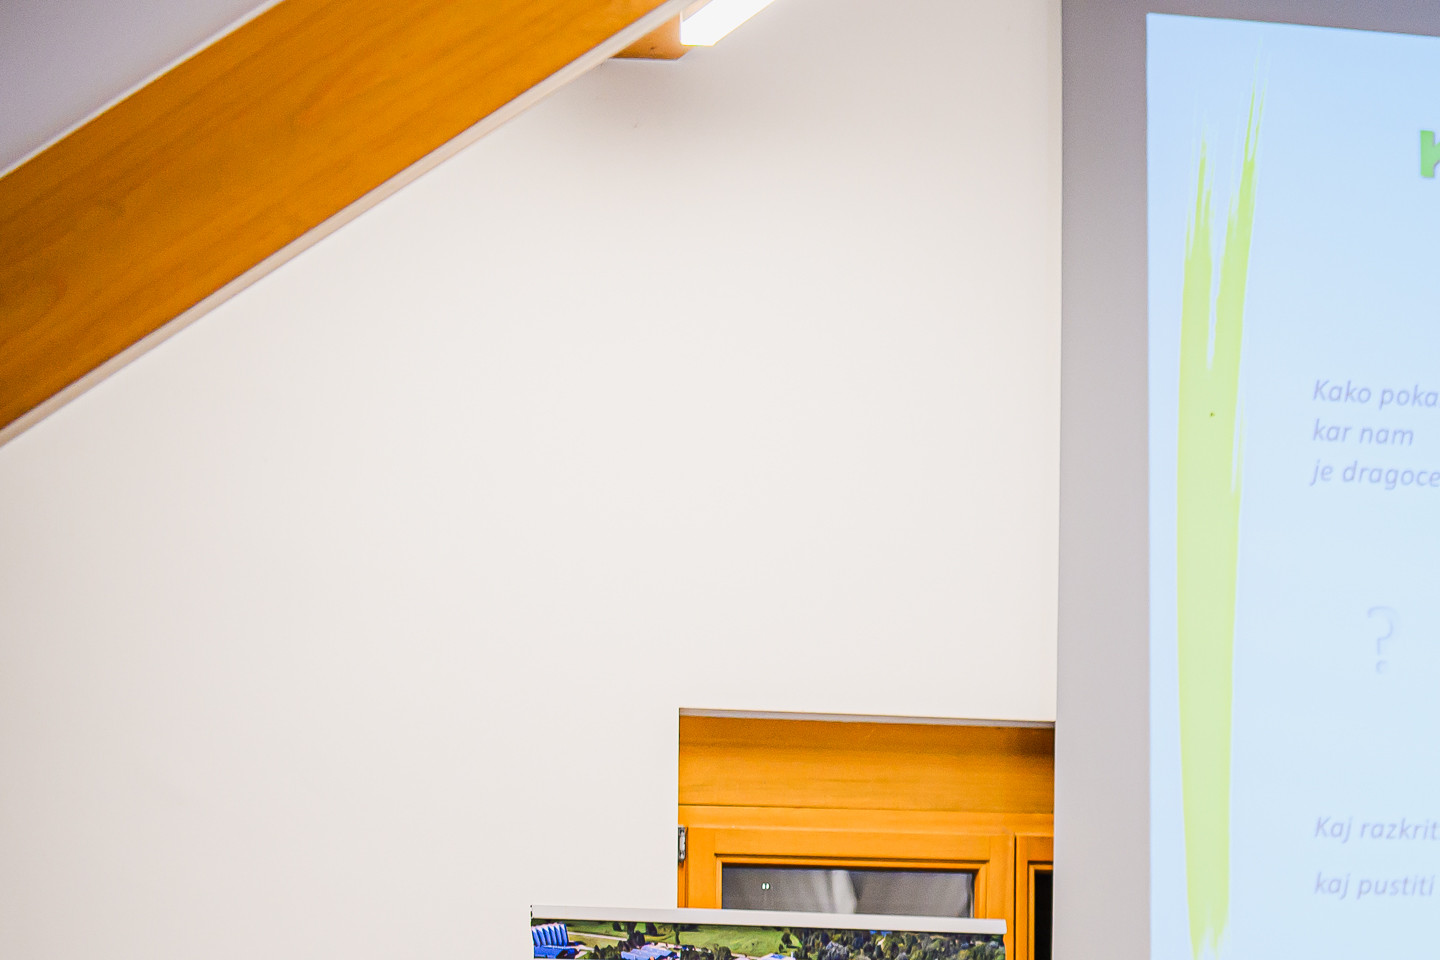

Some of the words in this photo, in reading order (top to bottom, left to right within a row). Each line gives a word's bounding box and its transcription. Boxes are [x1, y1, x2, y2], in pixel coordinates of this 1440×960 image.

[1312, 379, 1372, 404] Kako
[1312, 418, 1352, 443] kar
[1359, 425, 1415, 446] nam
[1309, 459, 1334, 487] je
[1366, 605, 1399, 675] ?
[1313, 816, 1353, 844] Kaj
[1313, 871, 1351, 900] kaj
[1356, 875, 1436, 900] pustiti
